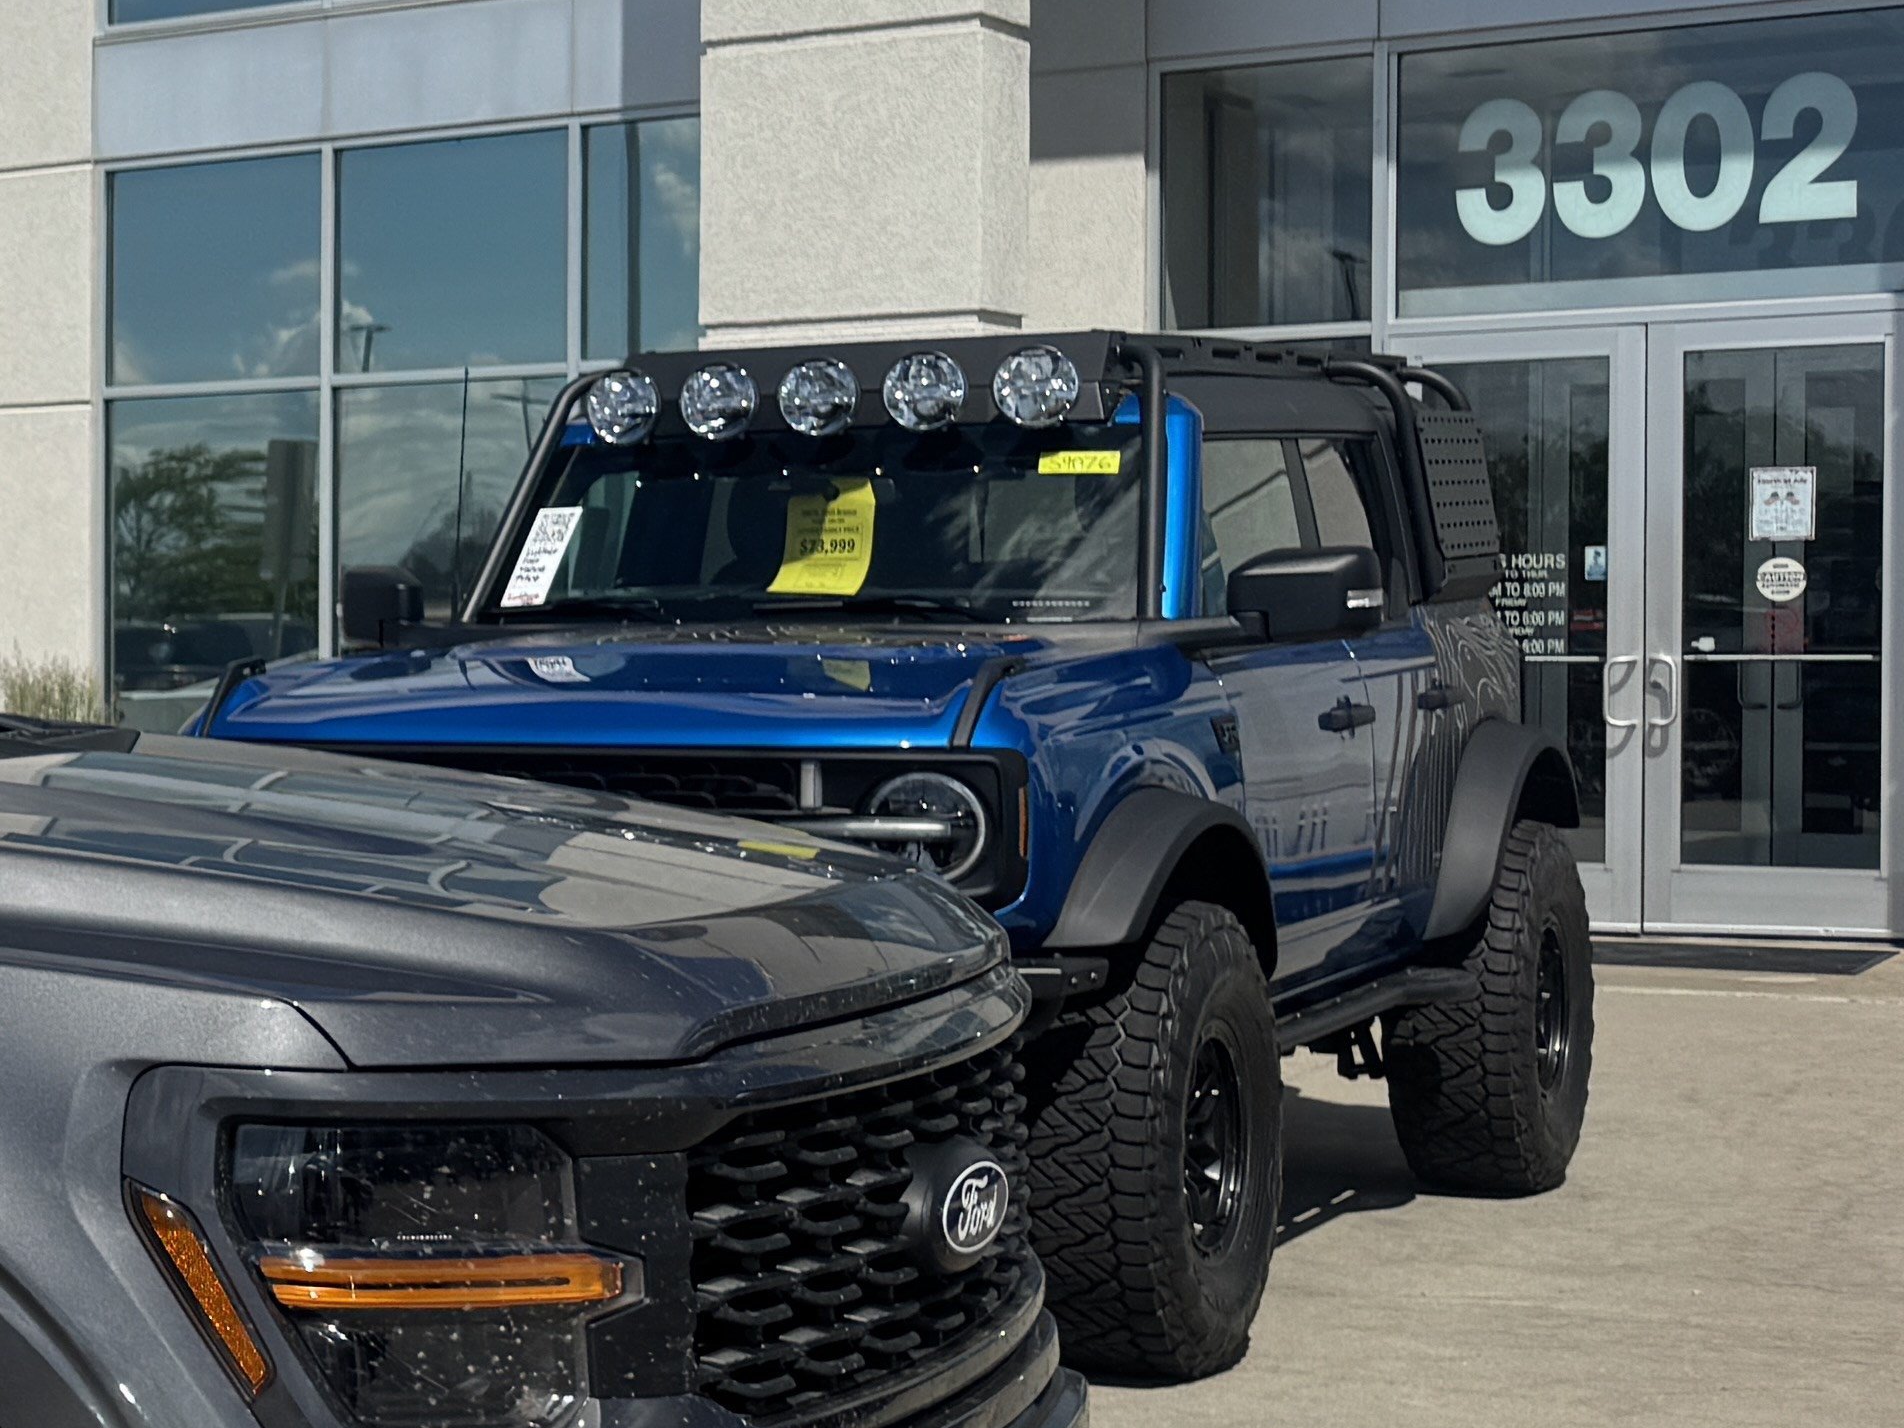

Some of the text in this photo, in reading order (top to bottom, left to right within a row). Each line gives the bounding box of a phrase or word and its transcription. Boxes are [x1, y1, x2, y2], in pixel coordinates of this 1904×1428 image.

[1455, 71, 1858, 246] 3302
[1511, 553, 1566, 569] HOURS
[1504, 582, 1521, 597] TO
[1548, 582, 1566, 597] PM
[1504, 610, 1520, 626] TO
[1547, 610, 1565, 626] PM
[1547, 638, 1565, 654] PM
[958, 1174, 998, 1242] Ford
